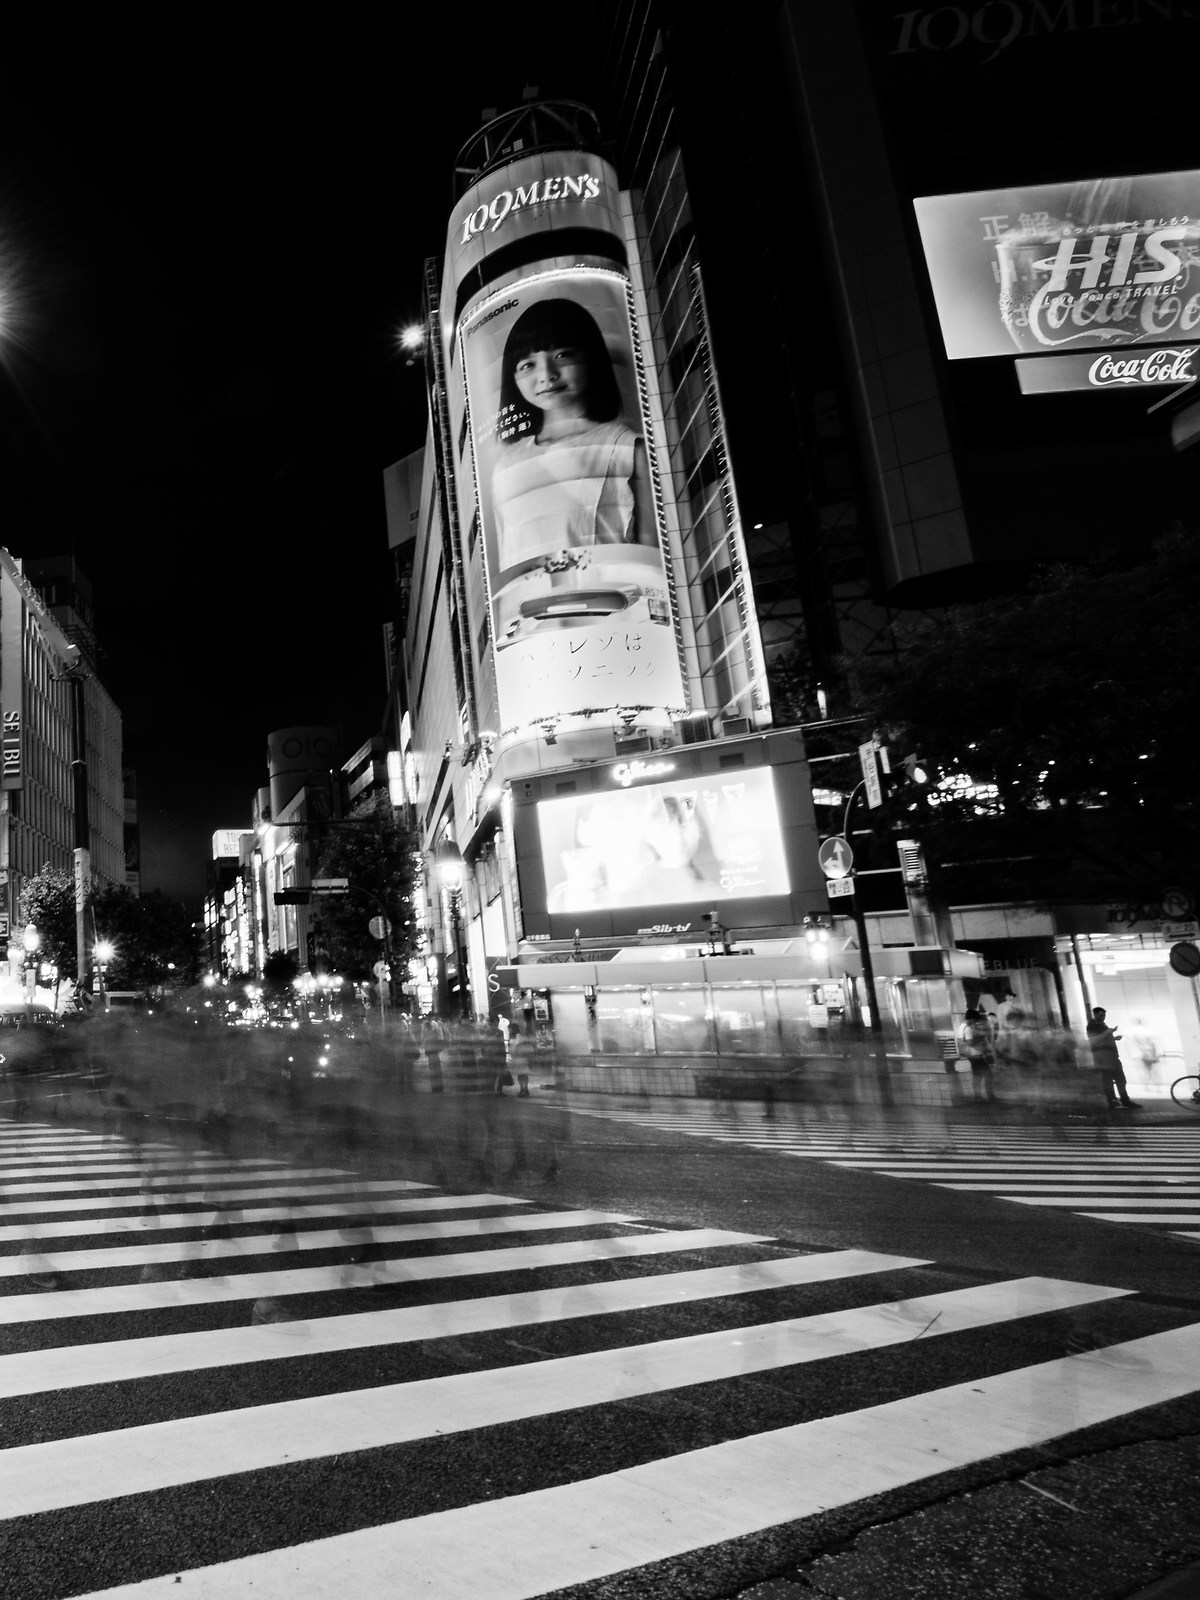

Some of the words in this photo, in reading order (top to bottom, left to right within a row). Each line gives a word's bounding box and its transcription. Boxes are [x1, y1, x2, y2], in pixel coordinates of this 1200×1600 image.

[461, 173, 600, 245] 109MEN'S
[467, 298, 520, 339] Panasonic
[3, 711, 20, 775] SEIBU
